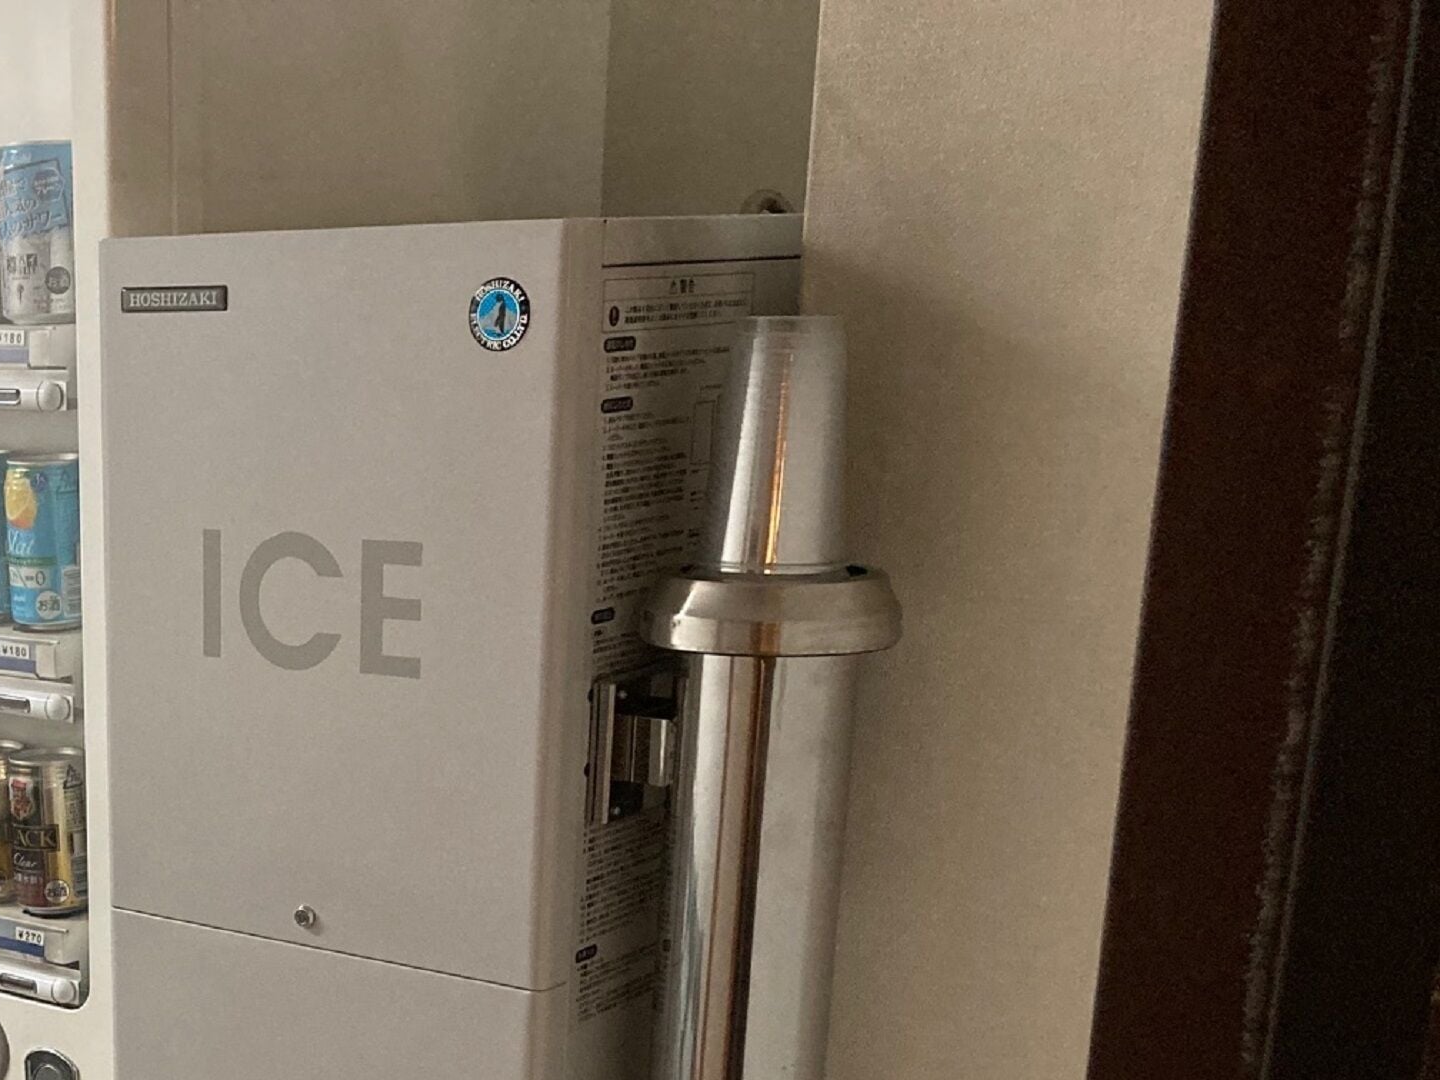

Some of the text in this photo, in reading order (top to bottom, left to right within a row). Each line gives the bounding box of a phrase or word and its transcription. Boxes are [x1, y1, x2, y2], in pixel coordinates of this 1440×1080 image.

[129, 291, 217, 308] HOSHIZAKI
[203, 528, 423, 679] ICE
[2, 646, 26, 657] ¥180
[18, 930, 41, 943] ¥270
